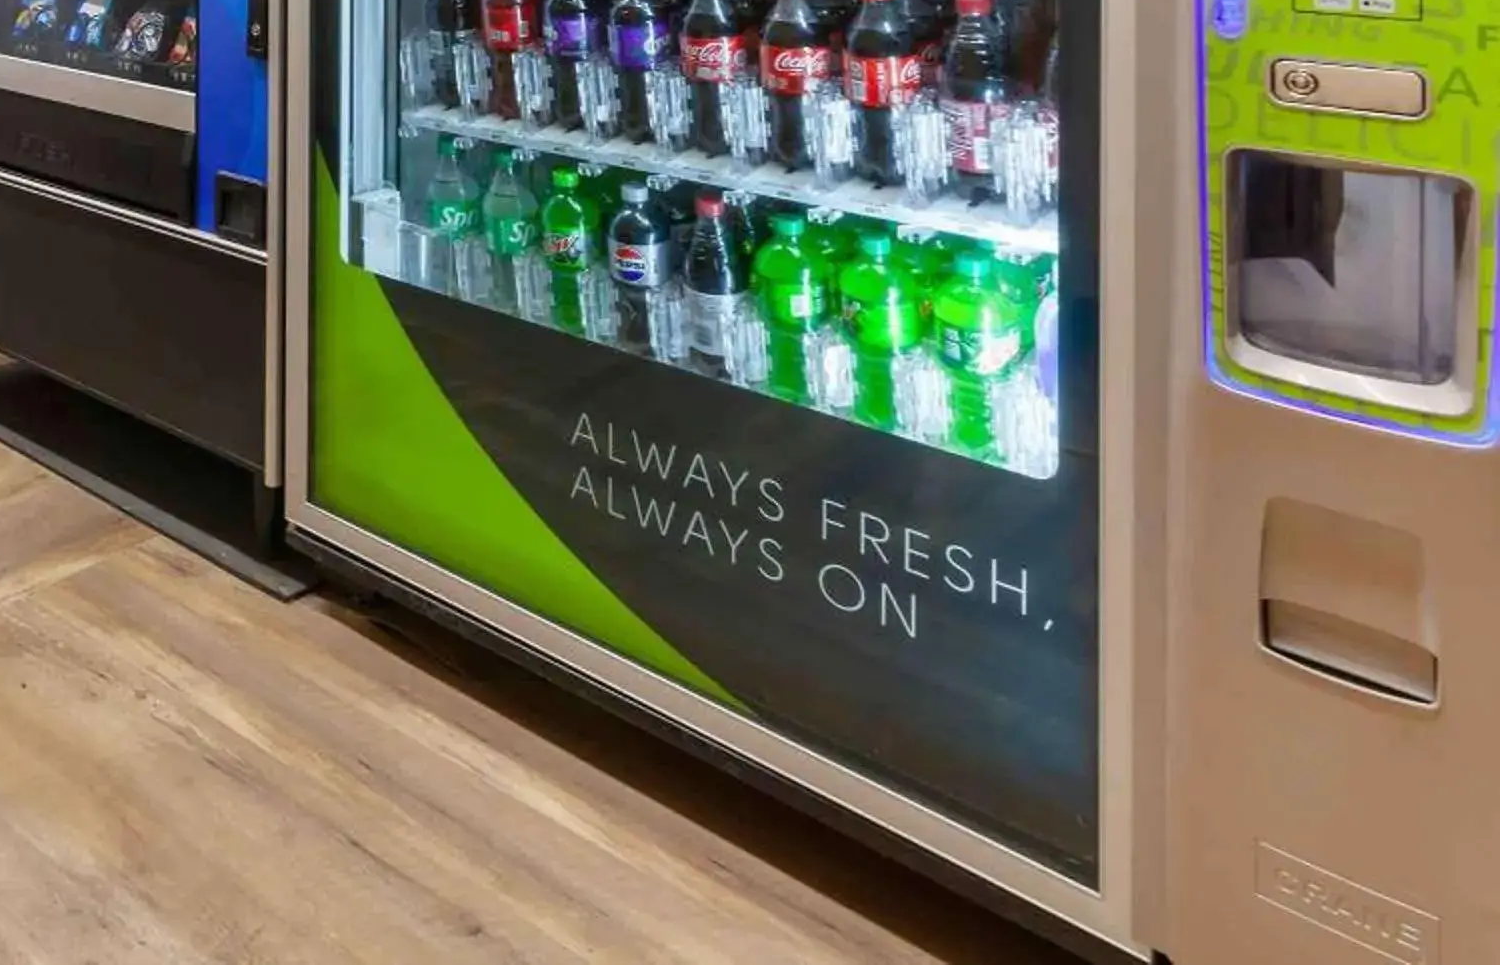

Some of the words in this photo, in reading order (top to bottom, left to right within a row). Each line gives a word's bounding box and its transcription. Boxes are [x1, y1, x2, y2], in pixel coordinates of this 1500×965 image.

[570, 412, 785, 522] ALWAYS
[821, 499, 1054, 631] FRESH,
[570, 467, 785, 582] ALWAYS
[818, 564, 917, 638] ON
